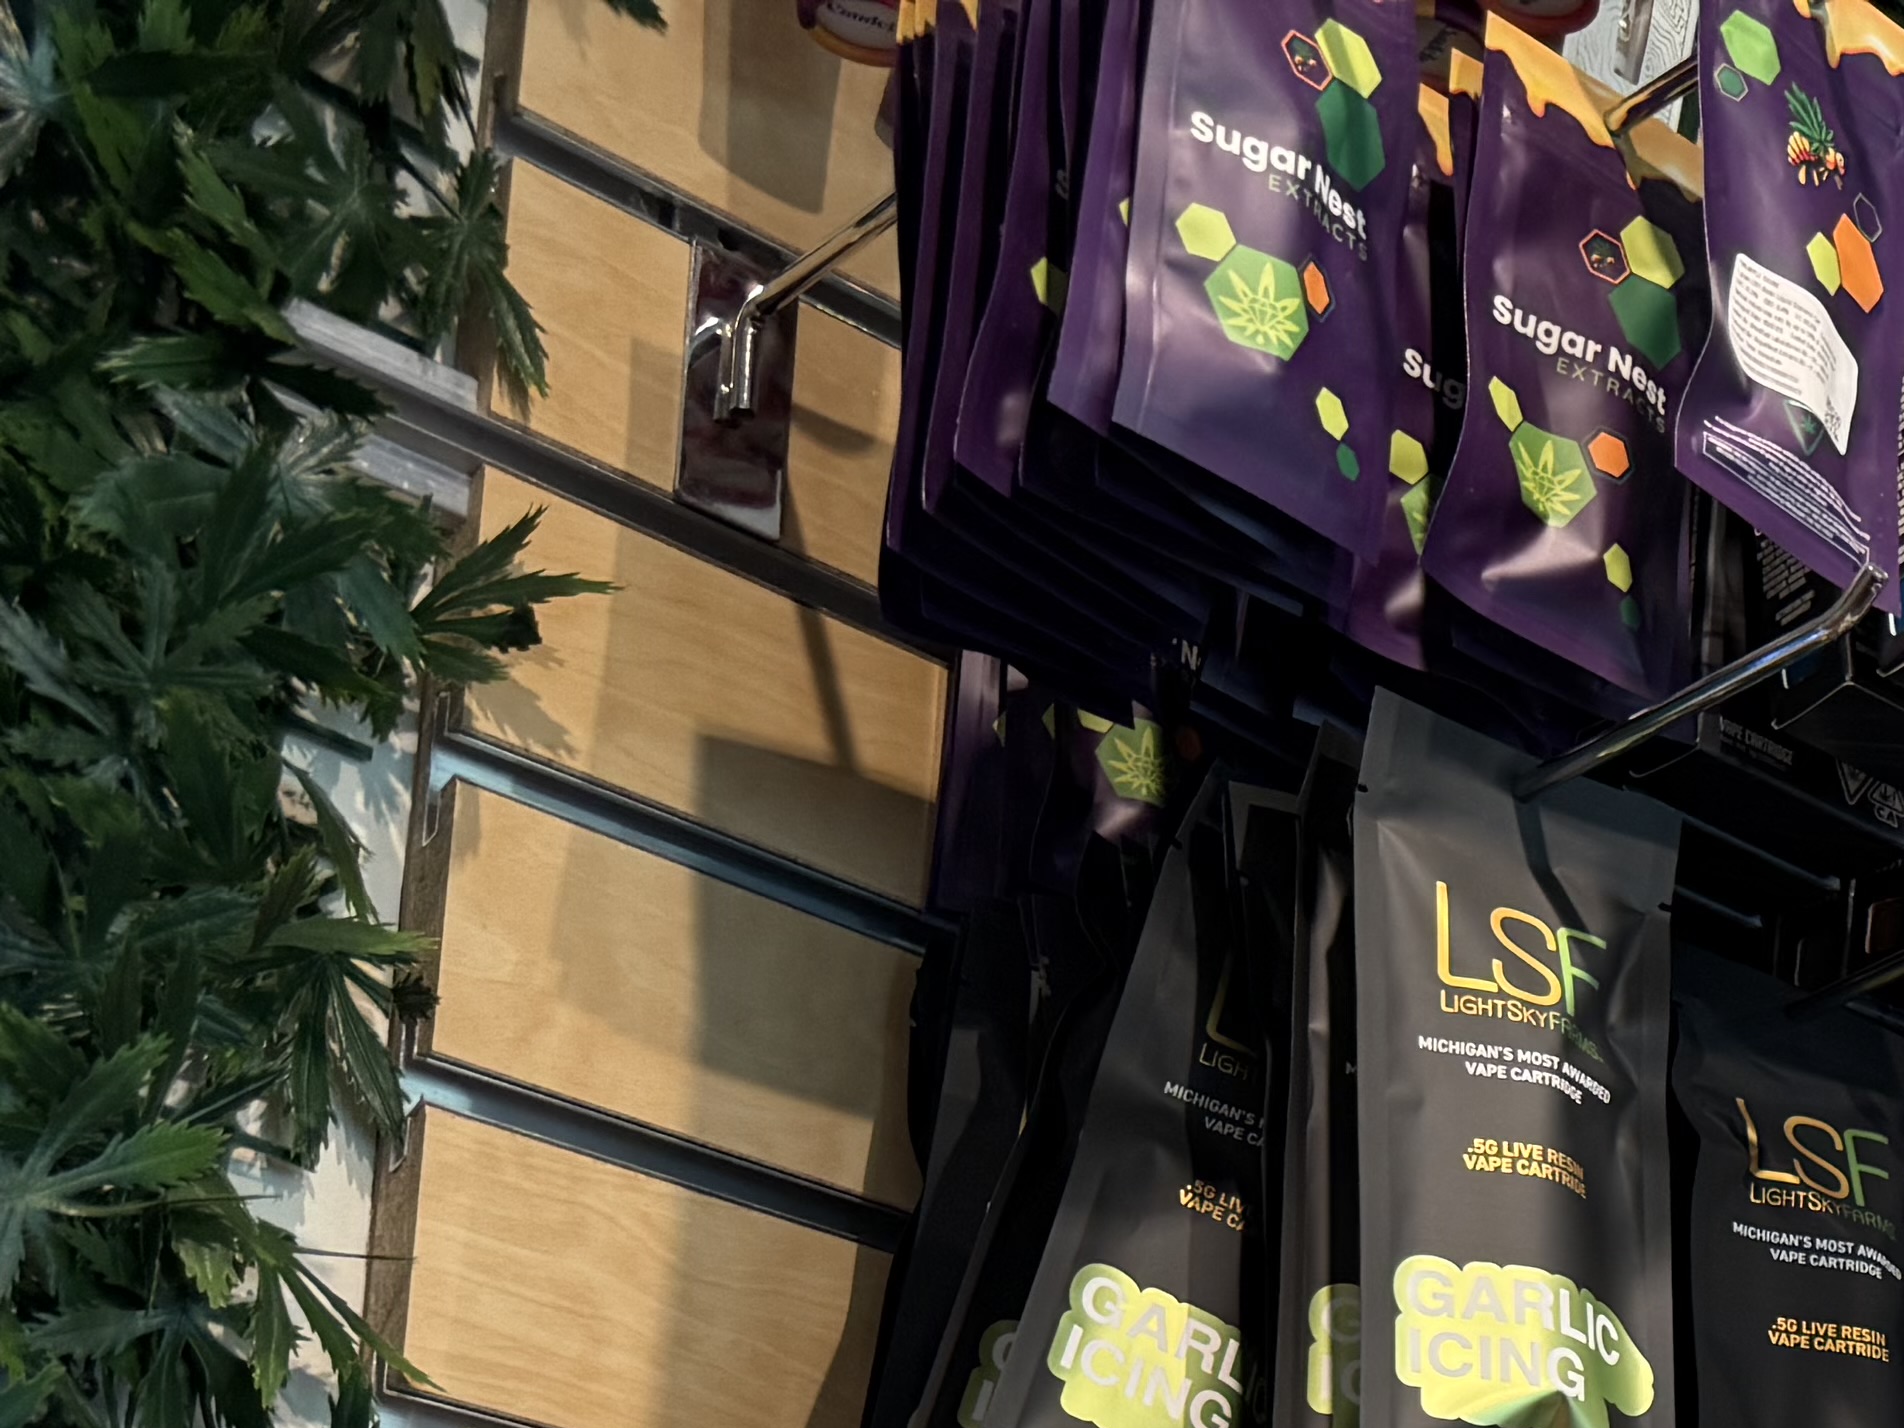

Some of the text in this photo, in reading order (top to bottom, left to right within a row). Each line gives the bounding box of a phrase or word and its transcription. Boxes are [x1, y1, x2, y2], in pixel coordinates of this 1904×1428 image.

[1189, 110, 1368, 240] Sugar Nest
[1267, 174, 1369, 262] EXTRACTS
[1491, 293, 1667, 415] Sugar Nest
[1436, 880, 1608, 1015] LSF
[1418, 1035, 1611, 1104] MICHIGAN'S MOST AWARDED
[1464, 1060, 1584, 1105] VAPE CARTRIDGE
[1462, 1152, 1514, 1174] VAPE
[1467, 1138, 1585, 1180] .5G LIVE RESIN
[1734, 1097, 1891, 1212] LSF
[1405, 1268, 1620, 1366] GARLIC
[1408, 1328, 1586, 1402] ICING
